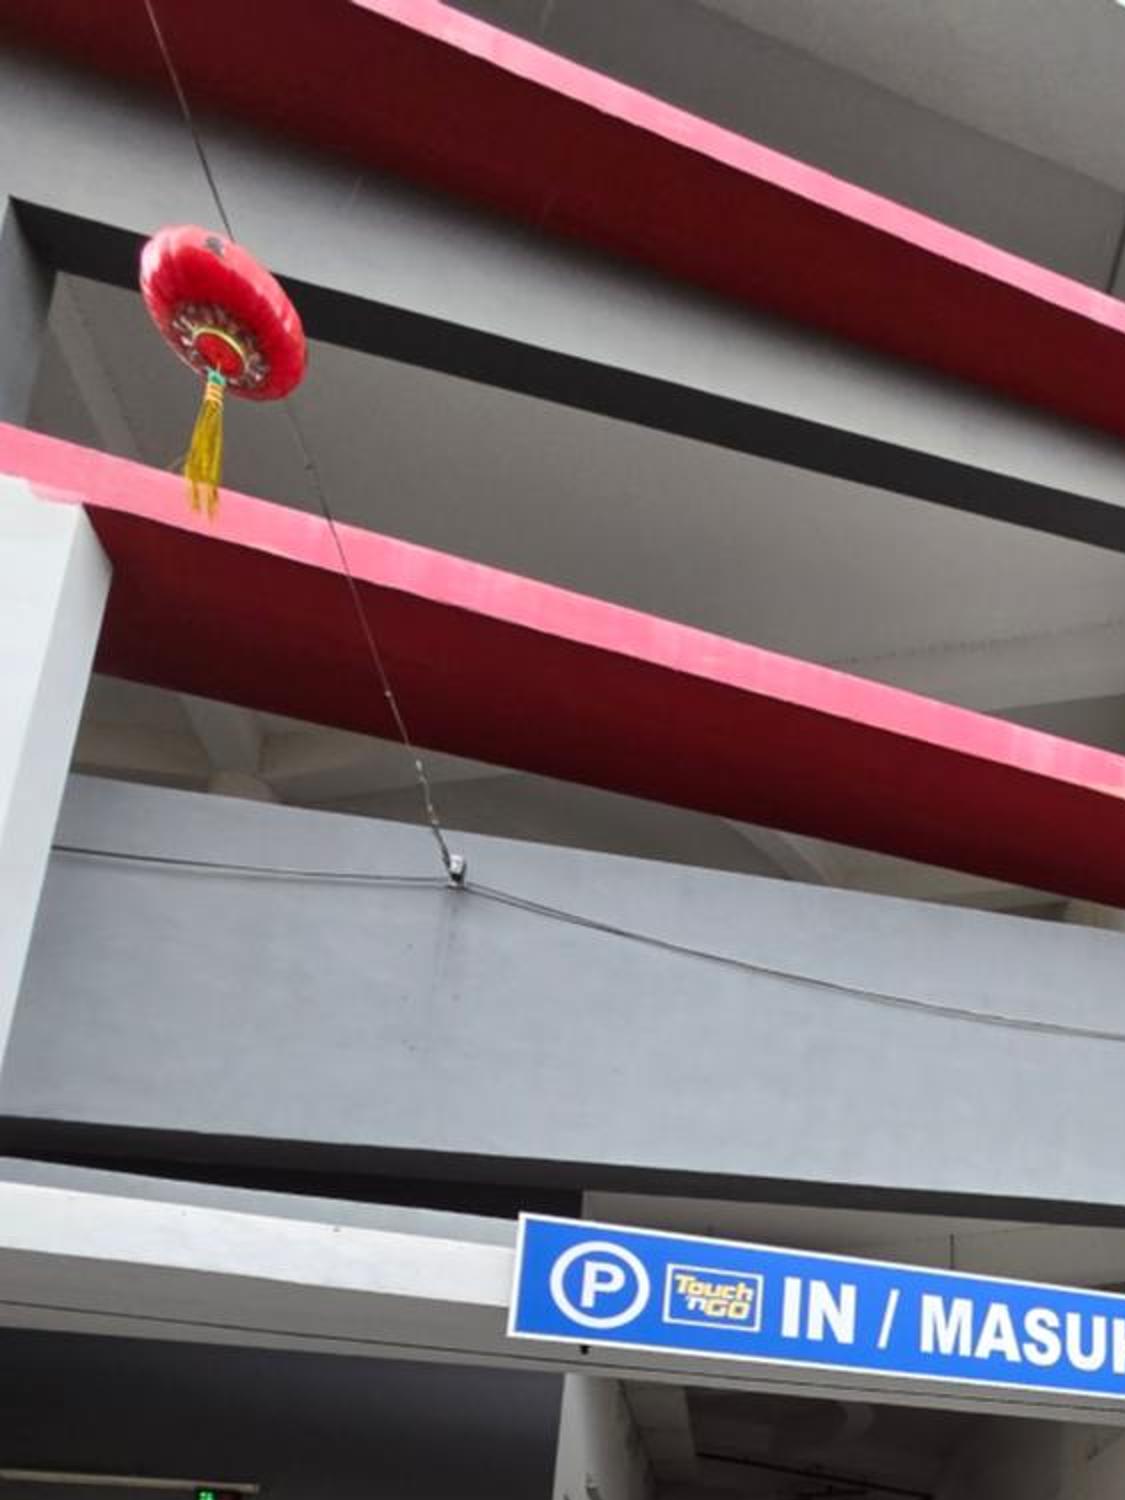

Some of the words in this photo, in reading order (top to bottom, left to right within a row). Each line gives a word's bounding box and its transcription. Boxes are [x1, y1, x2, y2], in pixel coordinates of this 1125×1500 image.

[580, 1260, 627, 1309] P
[674, 1273, 754, 1301] Touch
[781, 1275, 857, 1345] IN
[876, 1287, 900, 1350] /
